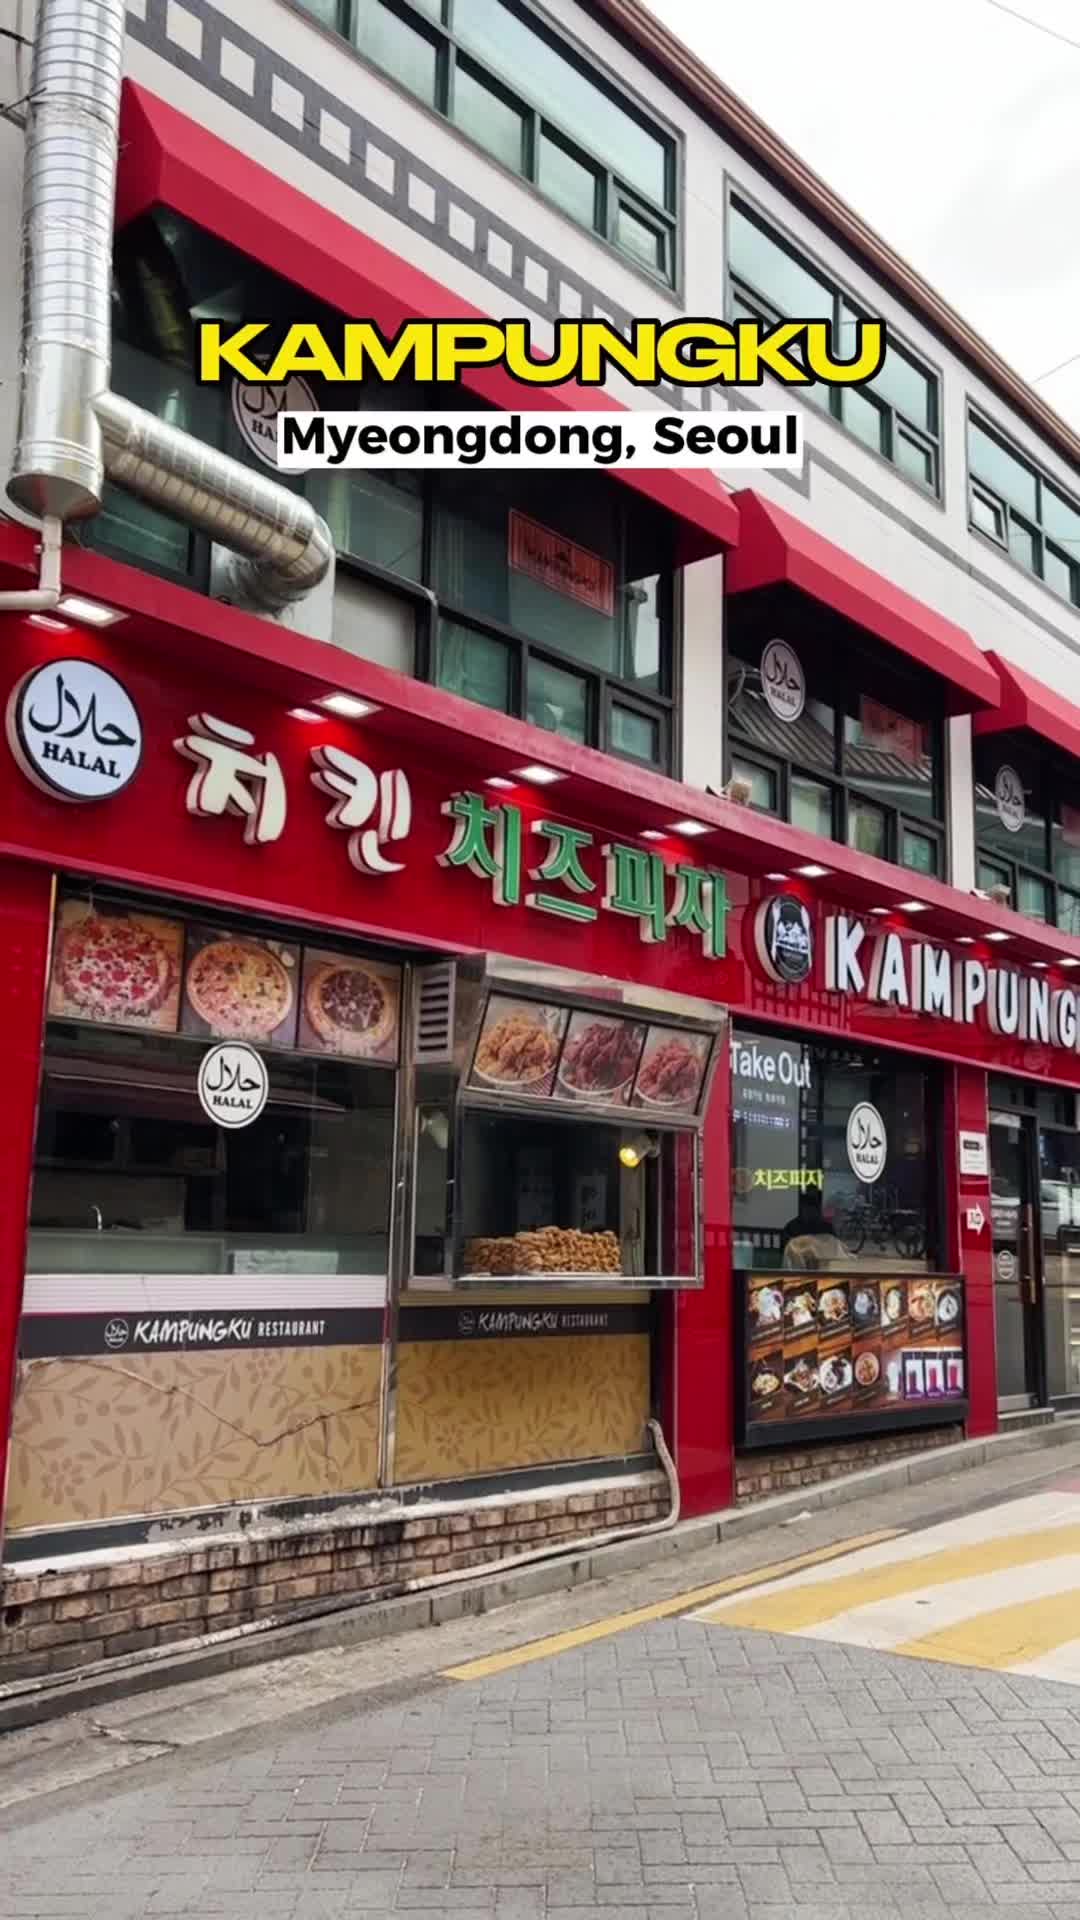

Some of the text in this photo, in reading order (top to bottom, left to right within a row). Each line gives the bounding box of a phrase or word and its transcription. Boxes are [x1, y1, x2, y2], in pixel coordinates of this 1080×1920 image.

[28, 672, 137, 747] حلال
[41, 741, 121, 779] HALAL
[436, 790, 732, 959] 치즈피자
[206, 1055, 261, 1092] حلال
[729, 1040, 812, 1089] Take Out
[212, 1095, 253, 1110] HALAL
[753, 1168, 825, 1192] 치즈피자
[133, 1316, 326, 1344] KAMPUNGKU RESTAURANT
[478, 1311, 559, 1332] KAMPUNGKU
